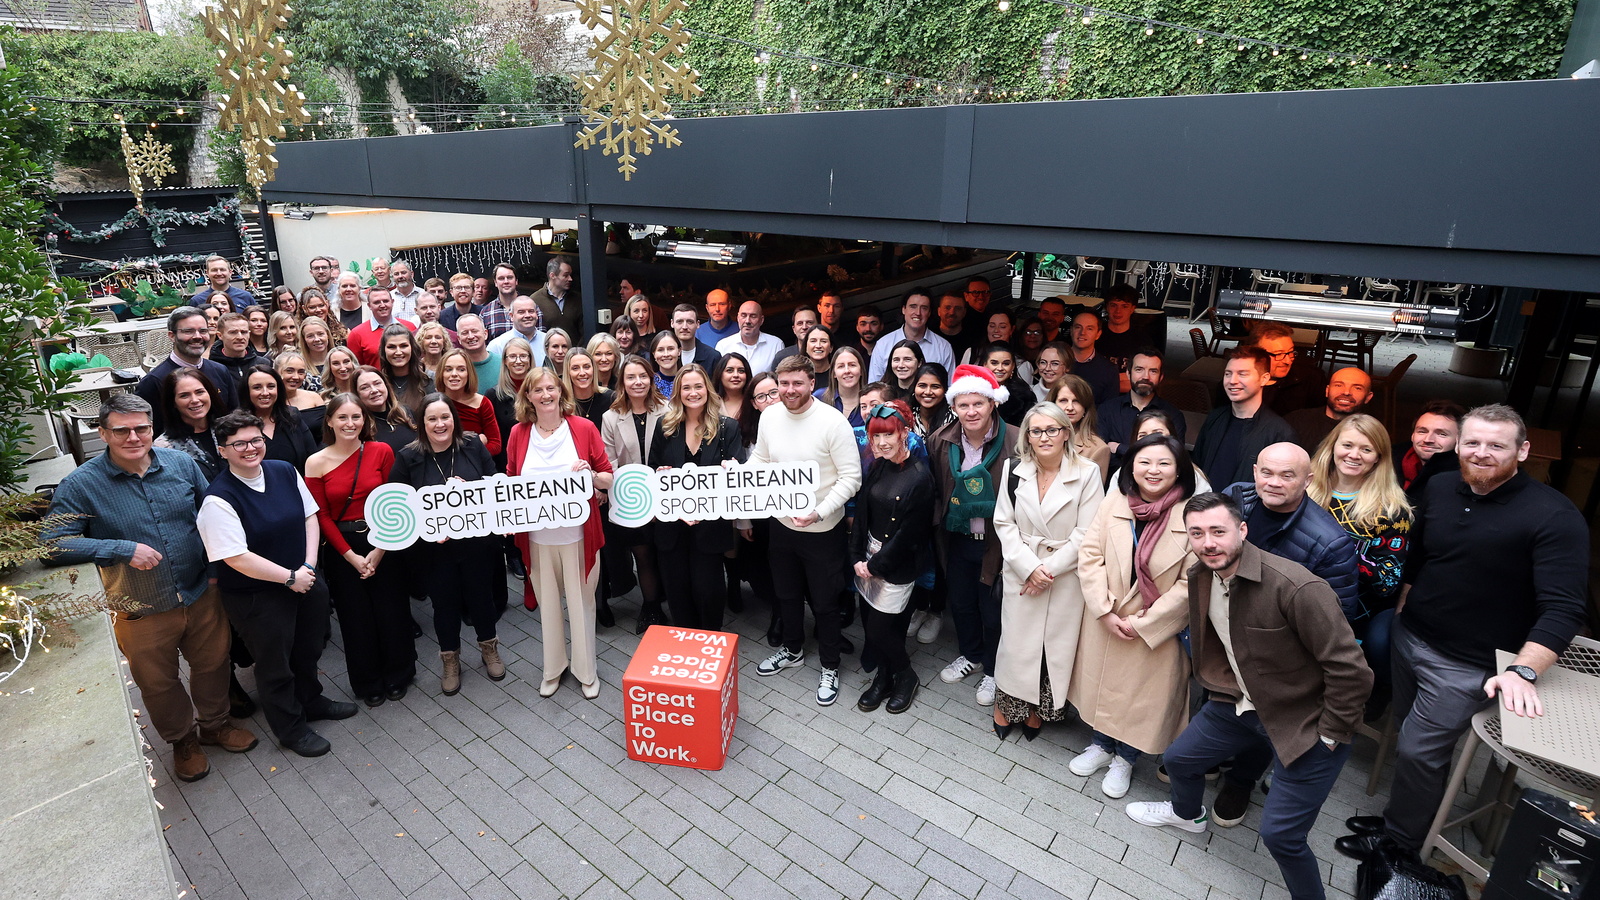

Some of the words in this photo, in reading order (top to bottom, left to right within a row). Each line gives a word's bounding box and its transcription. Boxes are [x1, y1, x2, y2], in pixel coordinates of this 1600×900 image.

[659, 469, 719, 492] SPÓRT
[726, 467, 814, 489] ÉIREANN
[422, 485, 487, 511] SPÓRT
[494, 475, 586, 503] ÉIREANN
[660, 496, 718, 515] SPORT
[725, 492, 809, 513] IRELAND
[425, 511, 488, 535] SPORT
[495, 501, 583, 528] IRELAND
[657, 653, 721, 671] Place
[701, 646, 725, 658] To
[649, 664, 717, 684] Great
[628, 685, 695, 709] Great
[631, 703, 695, 726] Place
[630, 722, 656, 739] To
